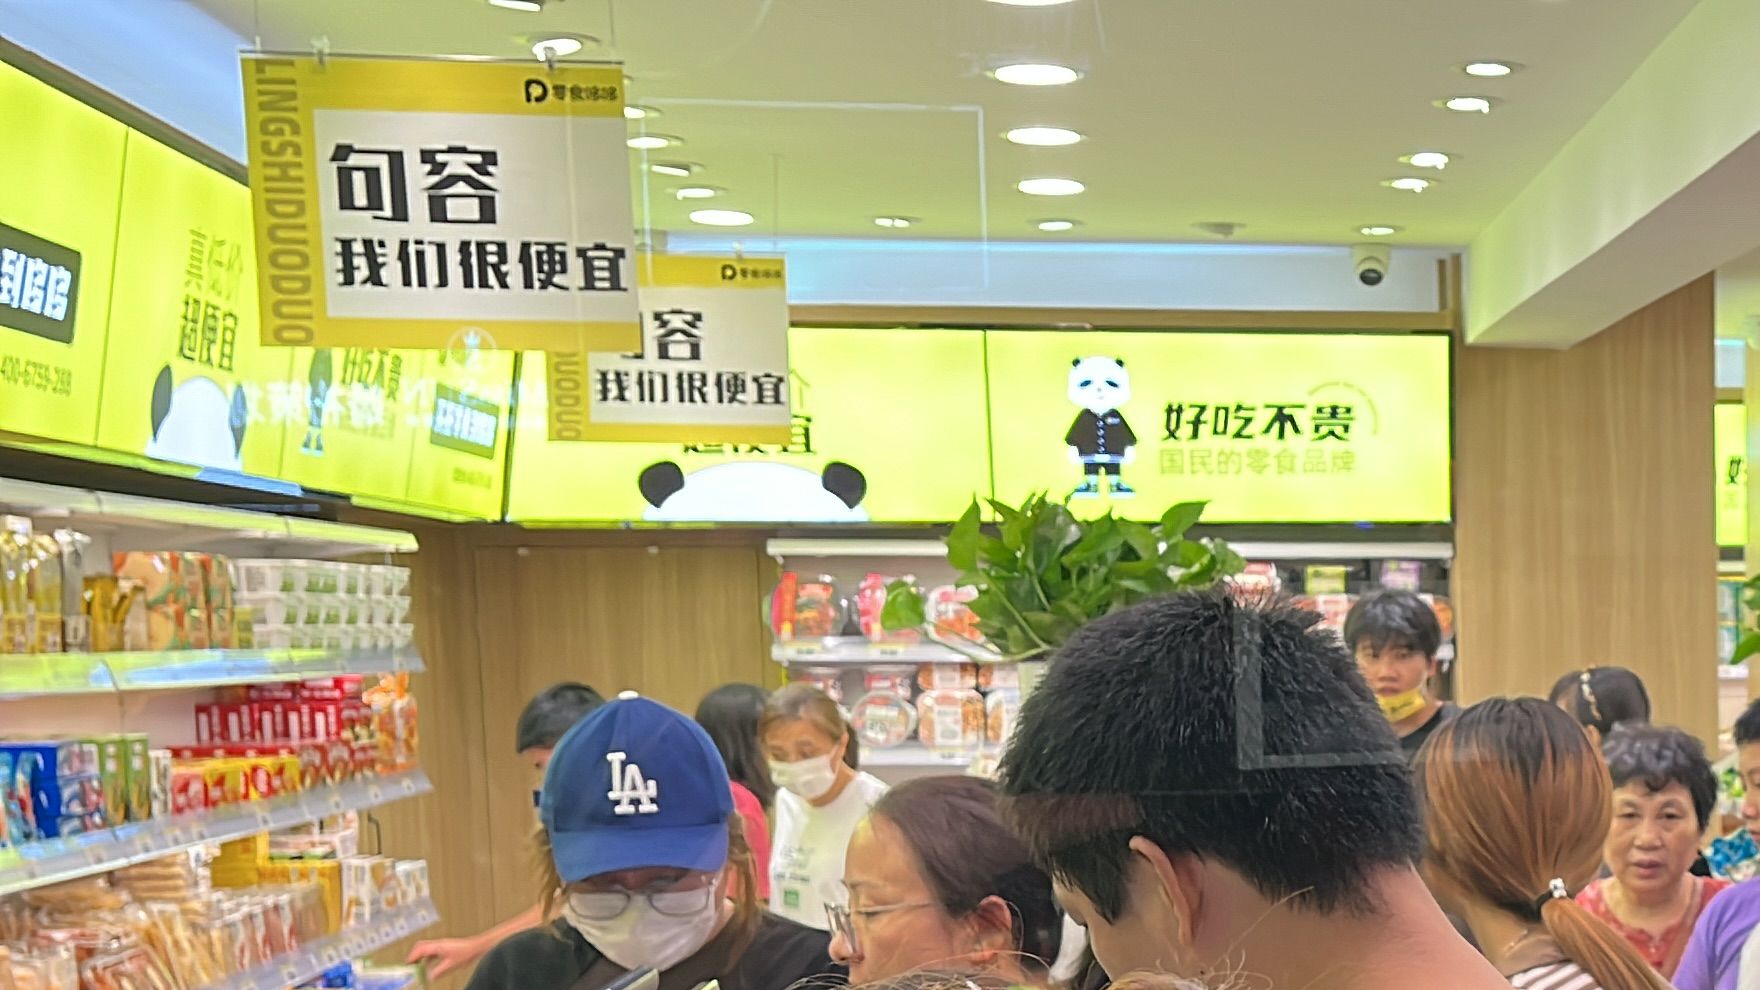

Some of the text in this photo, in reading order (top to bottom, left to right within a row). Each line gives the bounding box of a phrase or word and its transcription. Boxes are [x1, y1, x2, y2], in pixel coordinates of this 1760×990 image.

[255, 59, 314, 346] LINGSHIDUODUO
[330, 143, 499, 224] 句容
[334, 237, 628, 292] 我们很便宜
[598, 369, 786, 405] 我们很便宜
[1162, 403, 1357, 441] 好吃不贵
[1159, 448, 1357, 476] 国民的零食品牌
[606, 752, 659, 815] LA
